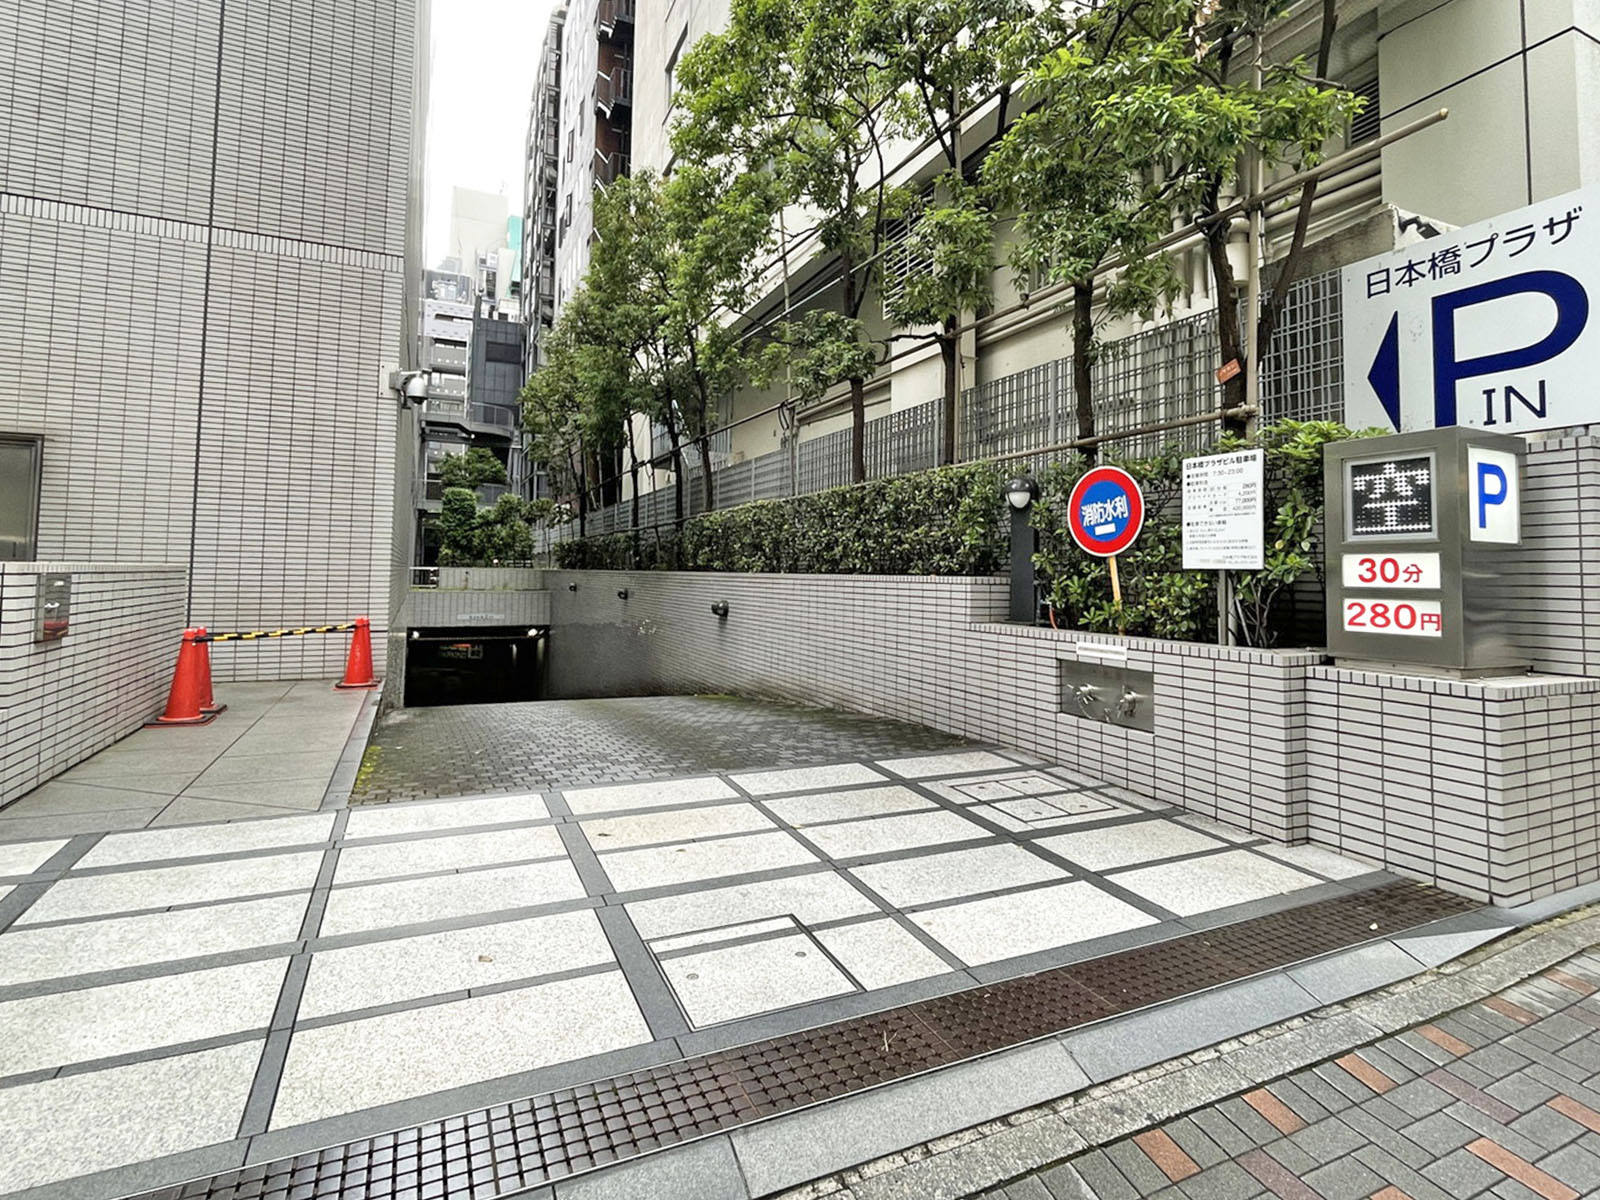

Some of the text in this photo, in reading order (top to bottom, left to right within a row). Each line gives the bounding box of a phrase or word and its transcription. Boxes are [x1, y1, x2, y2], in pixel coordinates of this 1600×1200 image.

[1367, 206, 1583, 299] 日本橋プラザ
[1431, 269, 1589, 428] P
[1482, 379, 1547, 426] IN
[1081, 494, 1129, 527] 消防水利
[1353, 462, 1431, 533] 空
[1477, 462, 1508, 529] P
[1358, 558, 1423, 583] 30分
[1347, 602, 1441, 631] 280円
